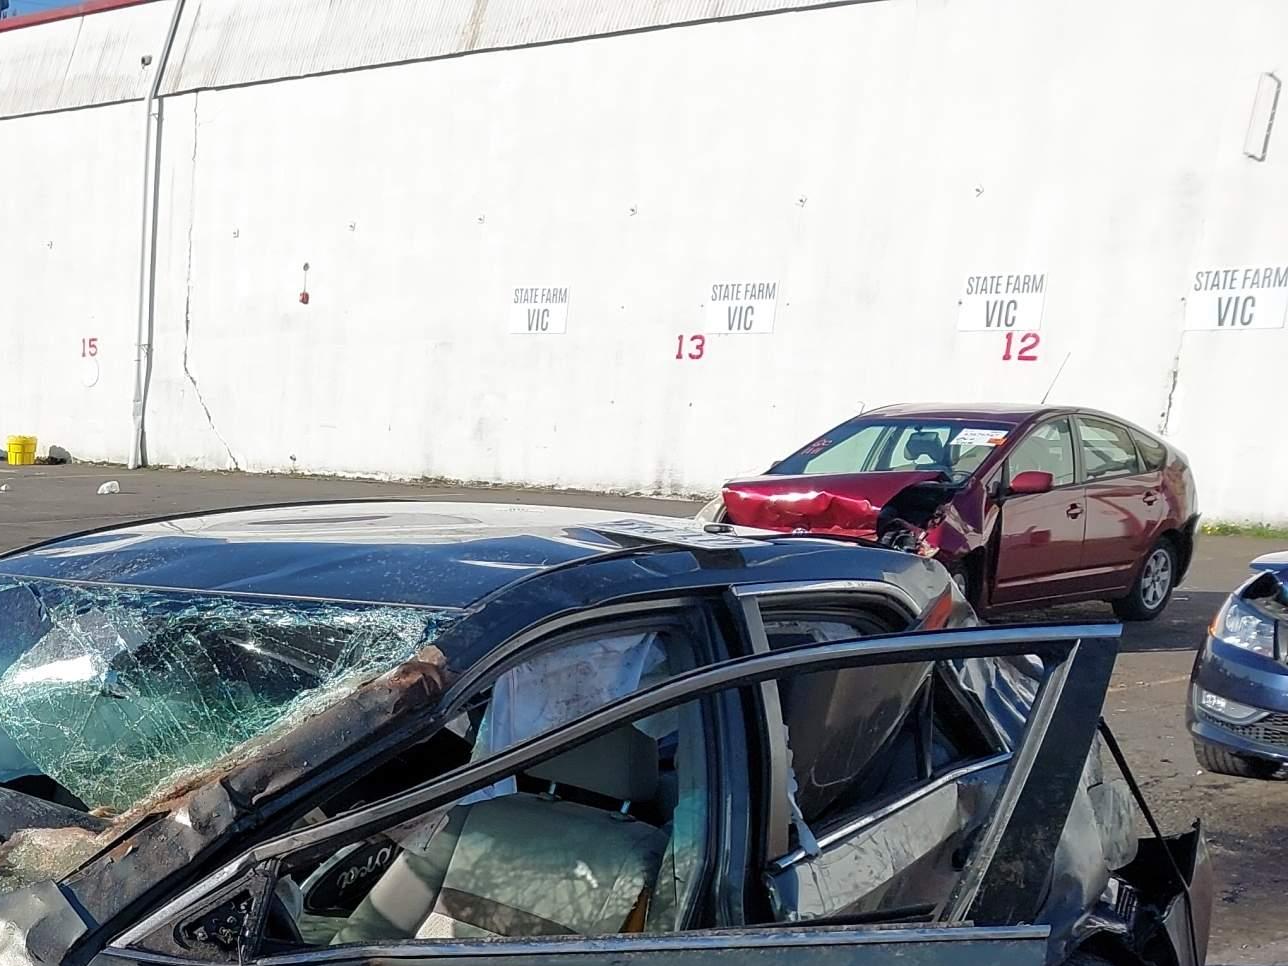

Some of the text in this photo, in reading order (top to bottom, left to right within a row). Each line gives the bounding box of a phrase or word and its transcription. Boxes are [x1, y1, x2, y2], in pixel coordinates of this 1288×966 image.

[966, 274, 1045, 295] STATE FARM
[1194, 266, 1288, 291] STATE FARM
[513, 288, 567, 304] STATE FARM
[712, 282, 776, 301] STATE FARM
[527, 308, 550, 331] VIC
[727, 305, 754, 331] VIC
[985, 299, 1018, 328] VIC
[1217, 295, 1256, 327] VIC
[81, 337, 98, 357] 15
[675, 334, 705, 359] 13
[1002, 332, 1040, 361] 12
